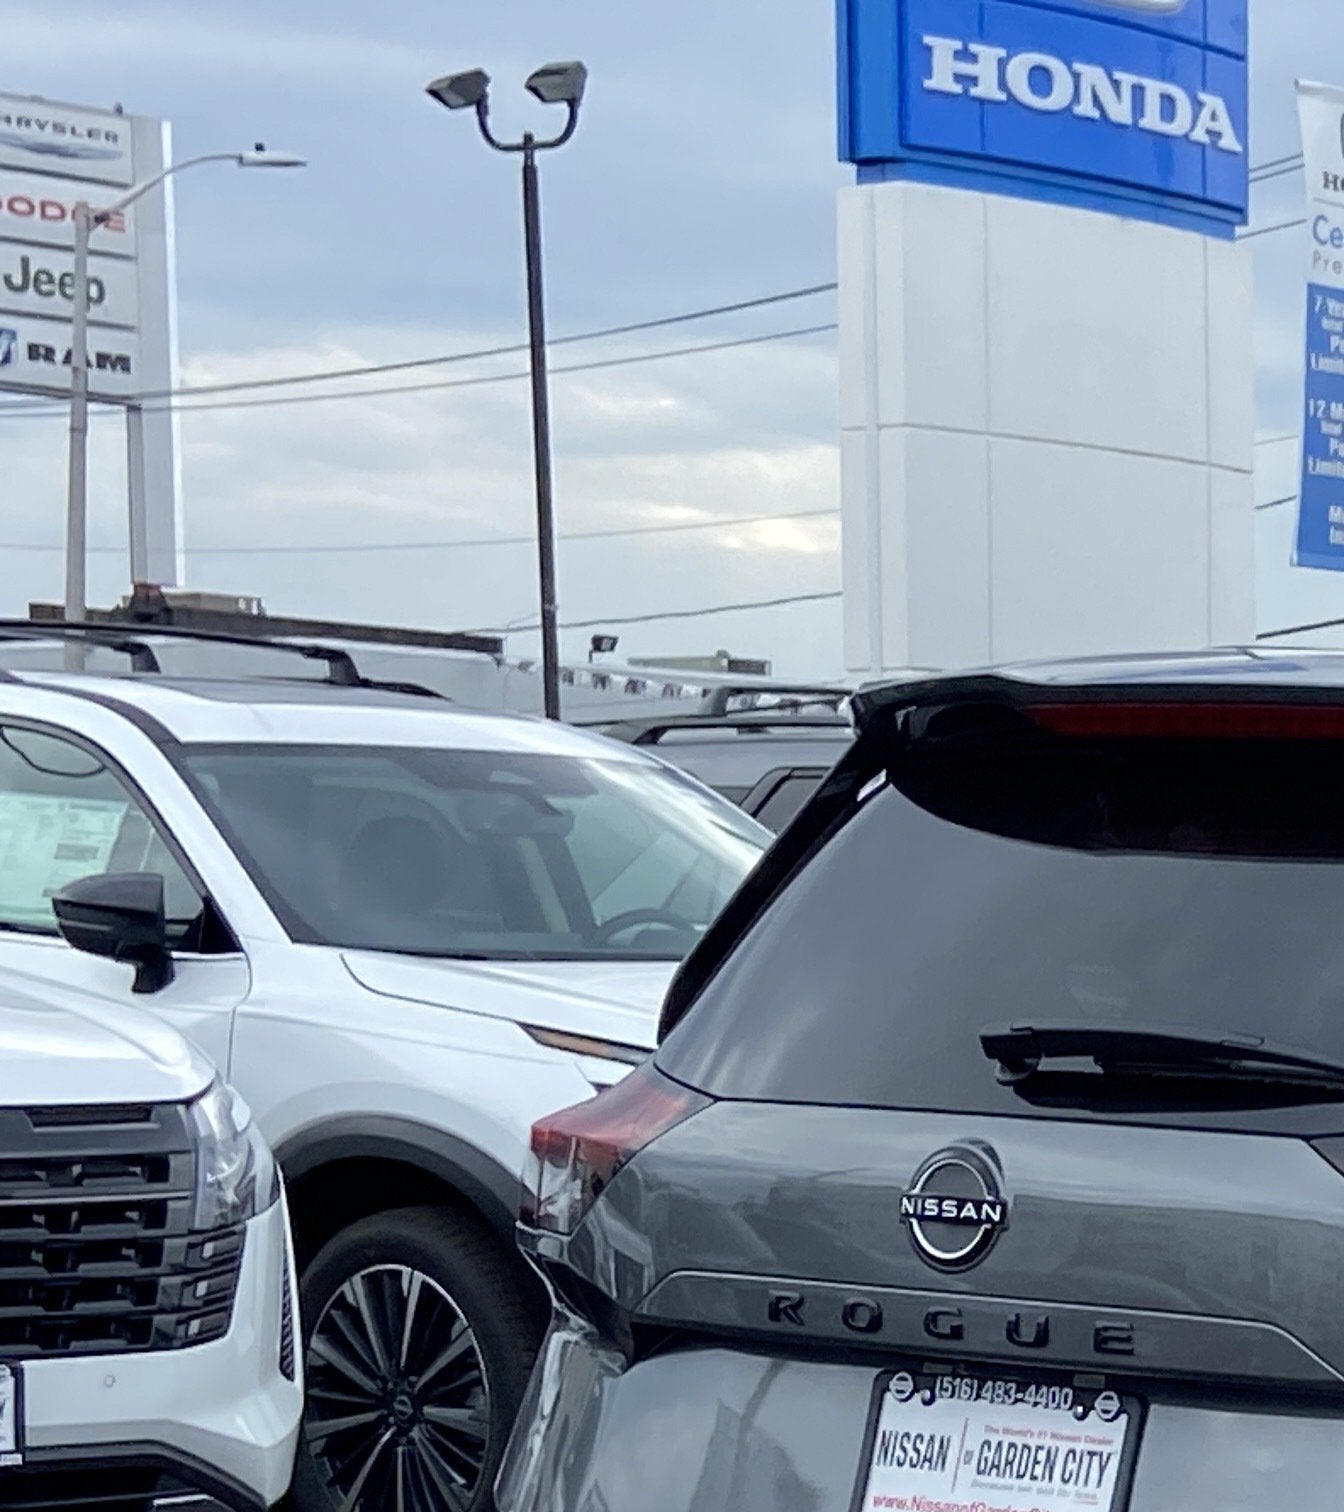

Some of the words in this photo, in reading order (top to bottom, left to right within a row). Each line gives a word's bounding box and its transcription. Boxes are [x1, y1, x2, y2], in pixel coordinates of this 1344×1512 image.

[922, 34, 1243, 154] HONDA
[0, 114, 118, 144] HRYSLER
[0, 196, 126, 232] ODE
[3, 255, 106, 312] Jeep
[27, 342, 131, 374] RAM
[1308, 398, 1326, 418] 12
[901, 1197, 1002, 1222] NISSAN
[767, 1289, 1136, 1358] ROGUE
[935, 1377, 979, 1401] (516)
[981, 1381, 1073, 1411] 483-4400
[875, 1430, 951, 1472] NISSAN
[976, 1439, 1060, 1483] GARDEN
[1060, 1447, 1112, 1488] CITY
